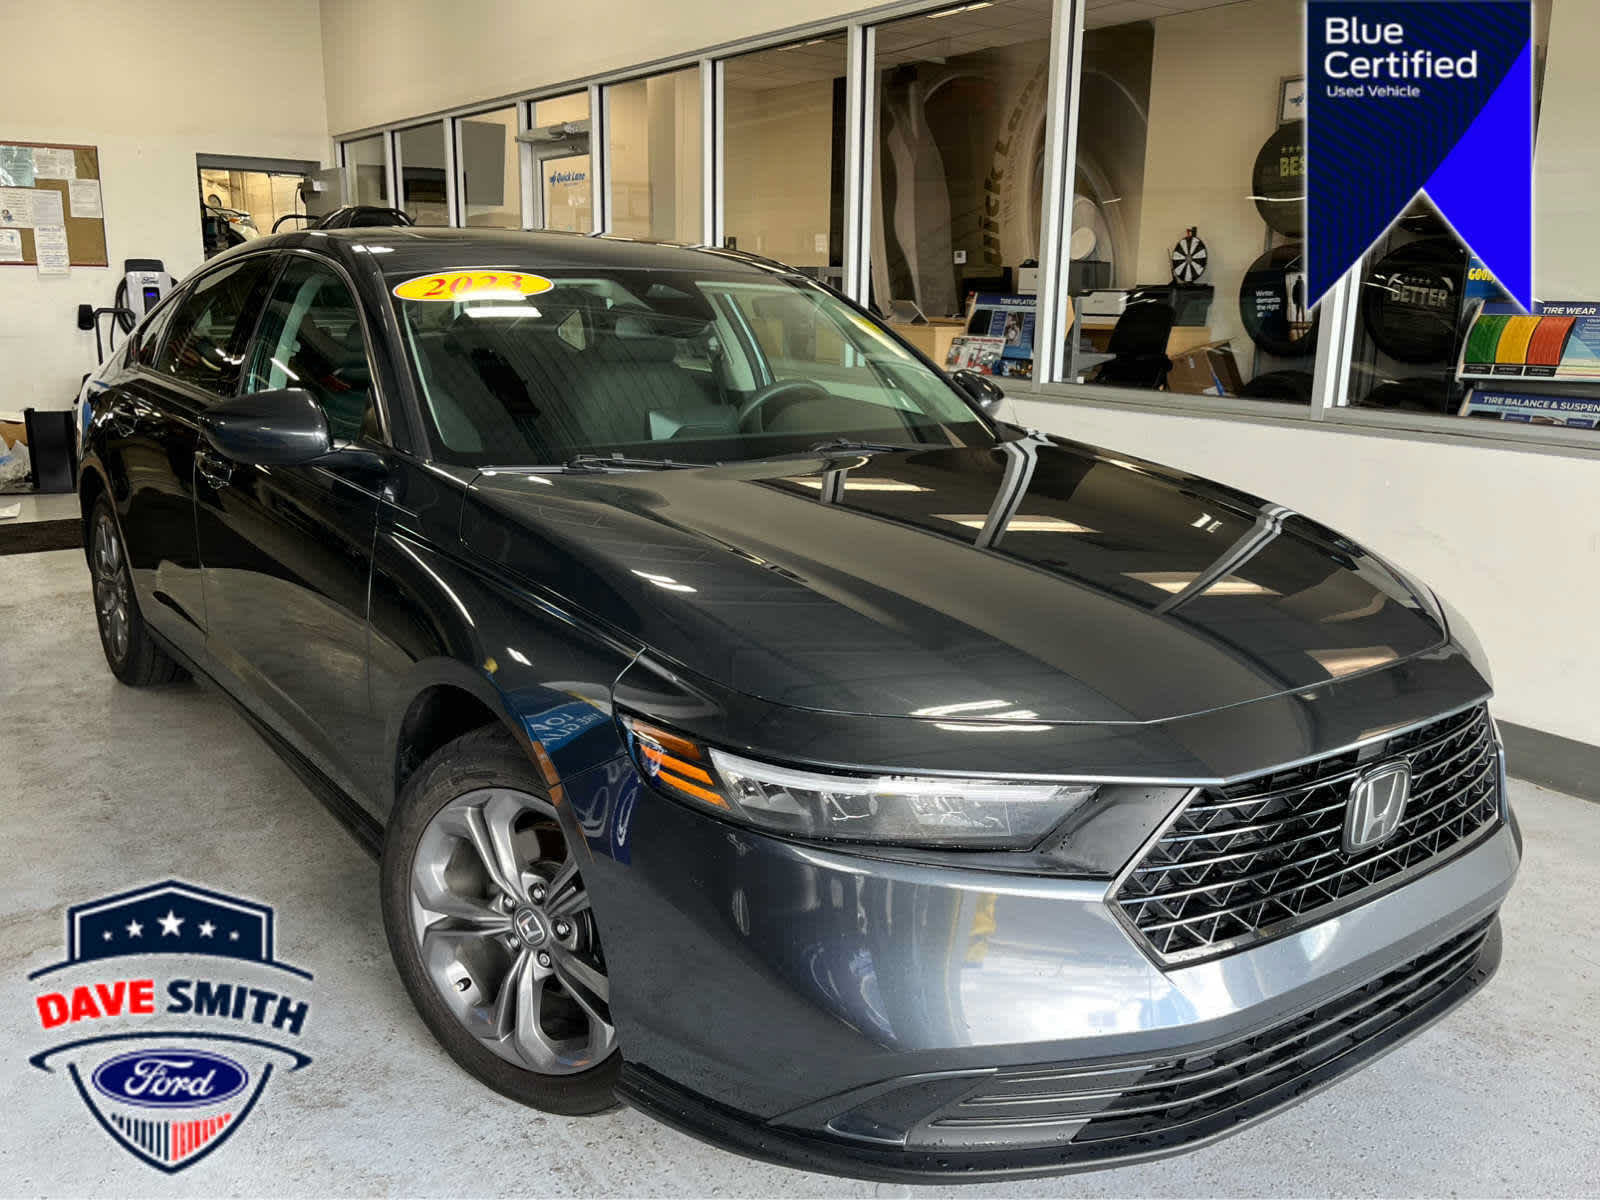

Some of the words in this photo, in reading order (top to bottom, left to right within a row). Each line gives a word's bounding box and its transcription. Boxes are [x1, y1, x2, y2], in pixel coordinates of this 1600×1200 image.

[423, 275, 524, 297] 2023
[1391, 284, 1449, 307] BETTER
[1542, 306, 1565, 315] TIRE
[1566, 307, 1597, 316] WEAR
[1483, 396, 1504, 404] TIRE
[1504, 397, 1551, 409] BALANCE
[1551, 401, 1558, 409] &
